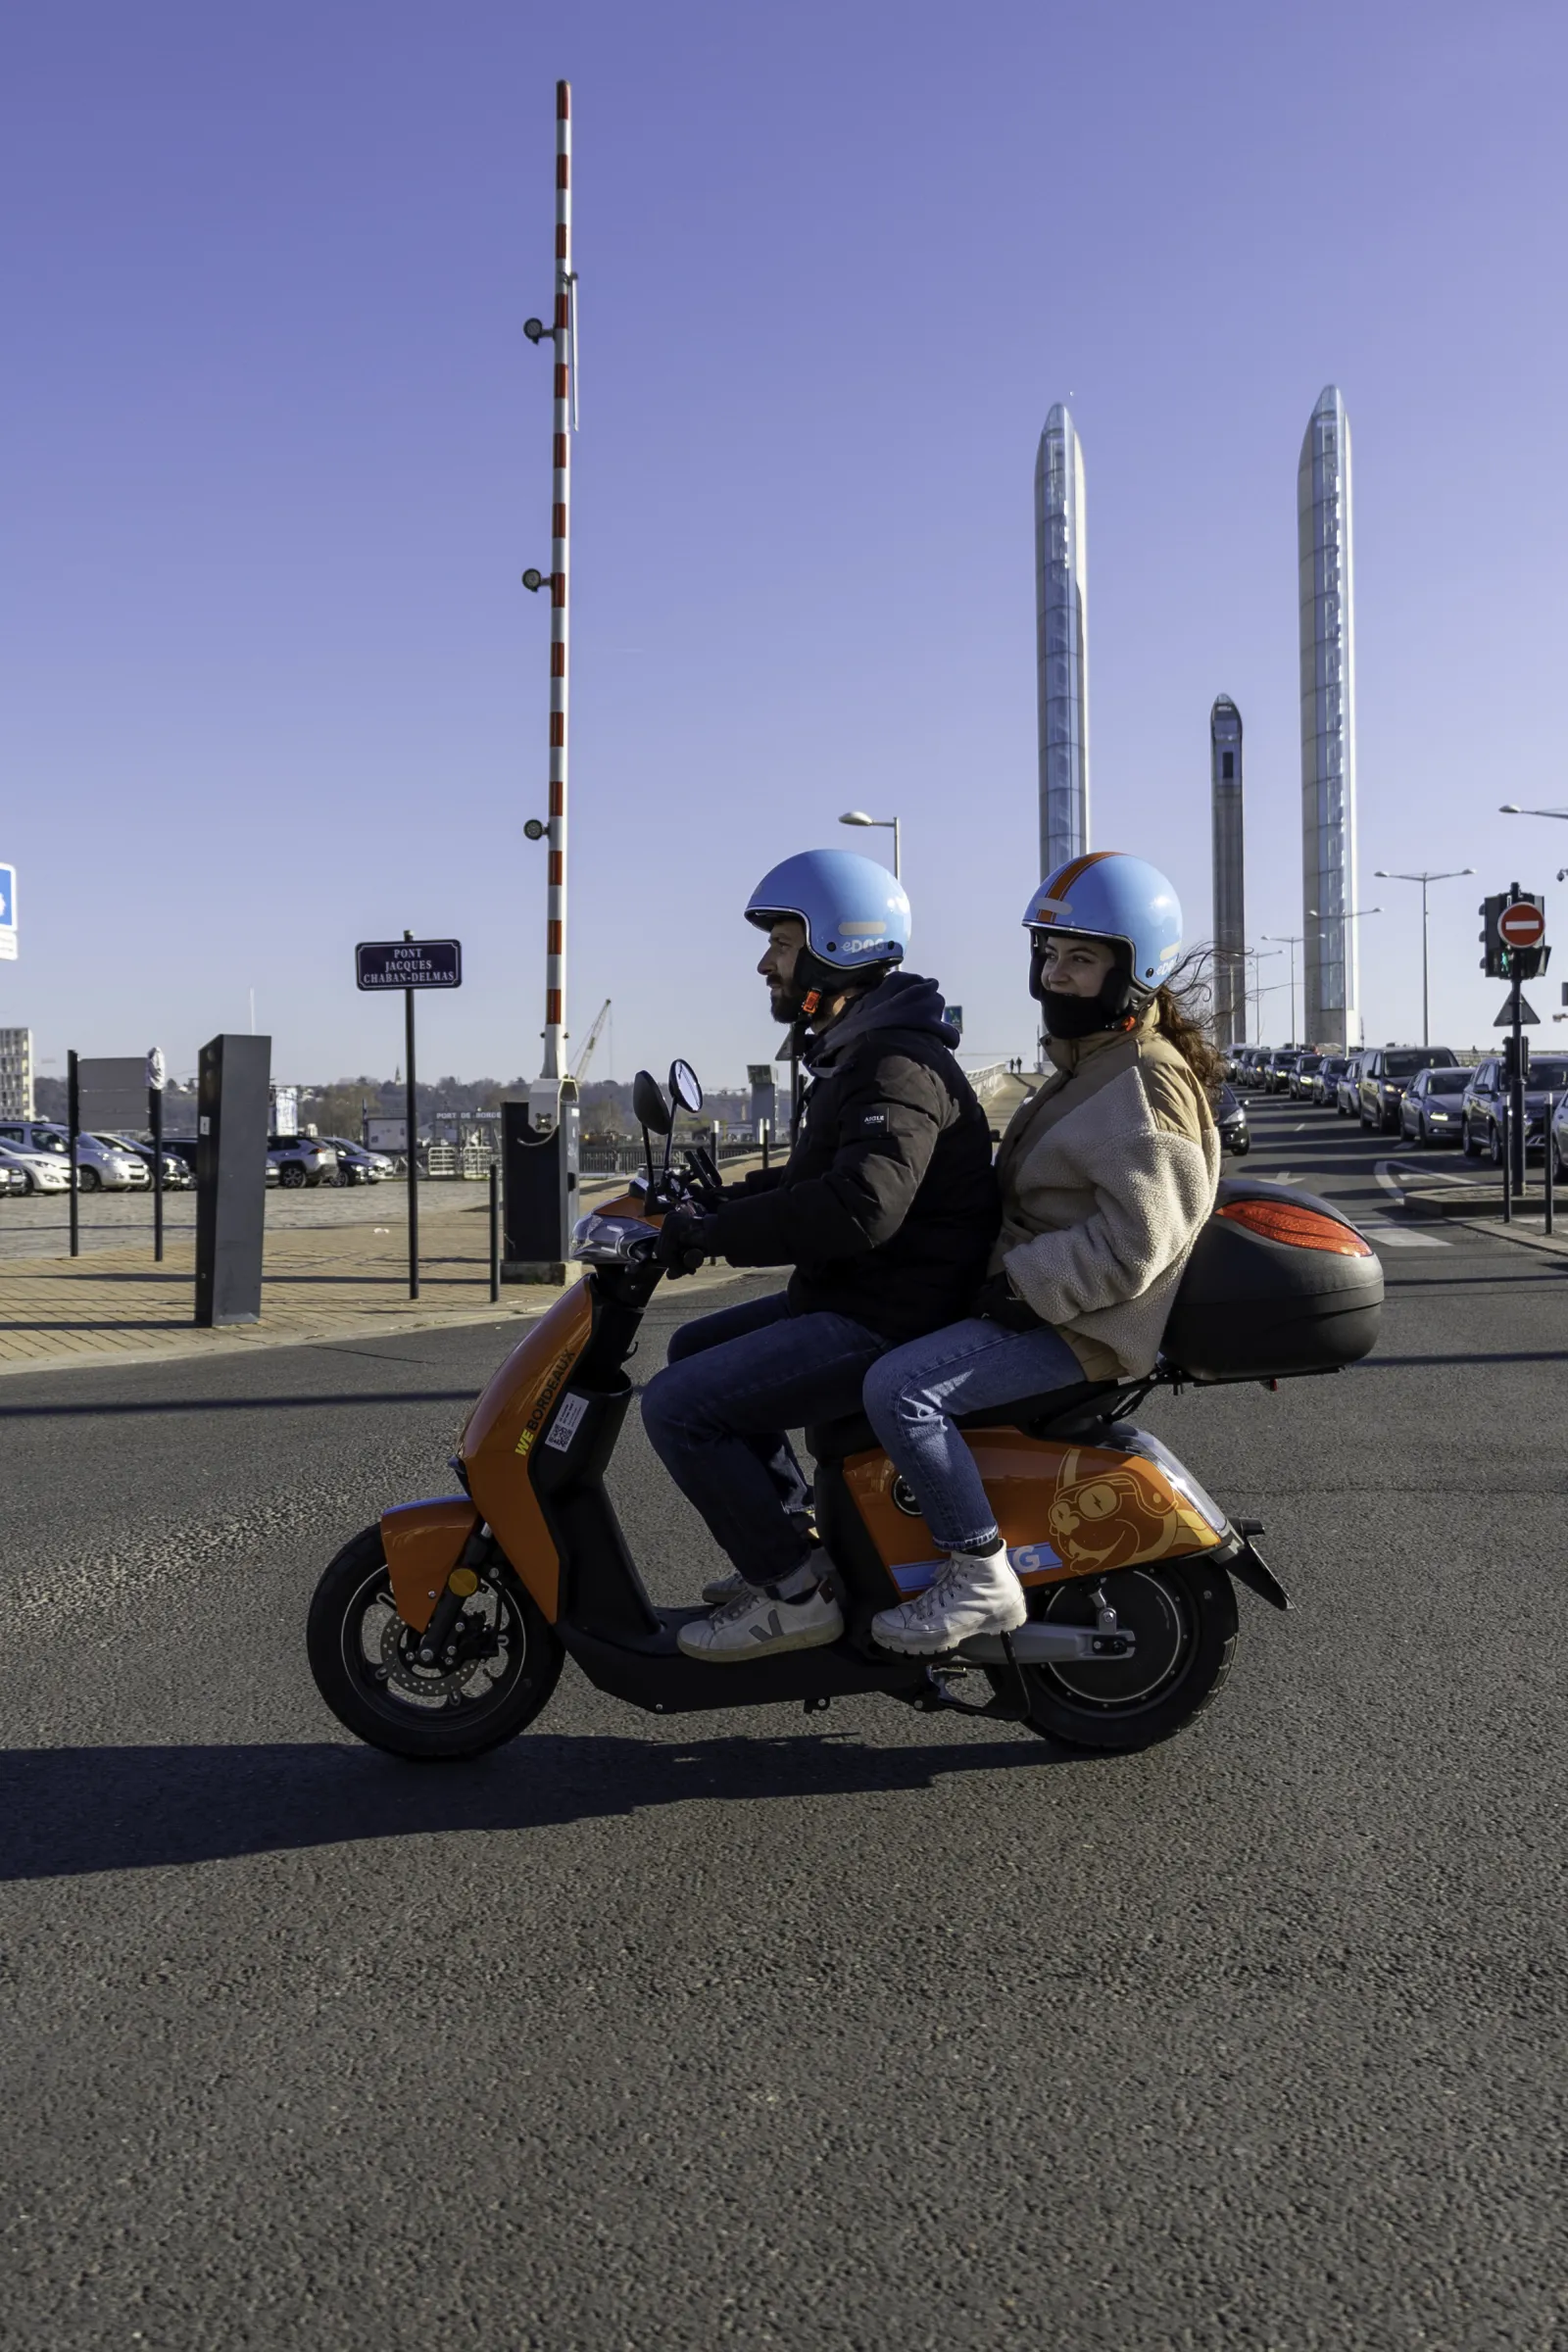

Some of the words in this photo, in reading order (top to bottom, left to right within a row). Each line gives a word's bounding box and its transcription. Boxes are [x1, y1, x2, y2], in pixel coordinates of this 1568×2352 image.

[393, 948, 422, 959] PONT
[384, 959, 432, 973] JACQUES
[363, 970, 455, 984] CHABAN-DELMAS
[514, 1428, 535, 1456] WE
[526, 1347, 576, 1432] BORDEAUX
